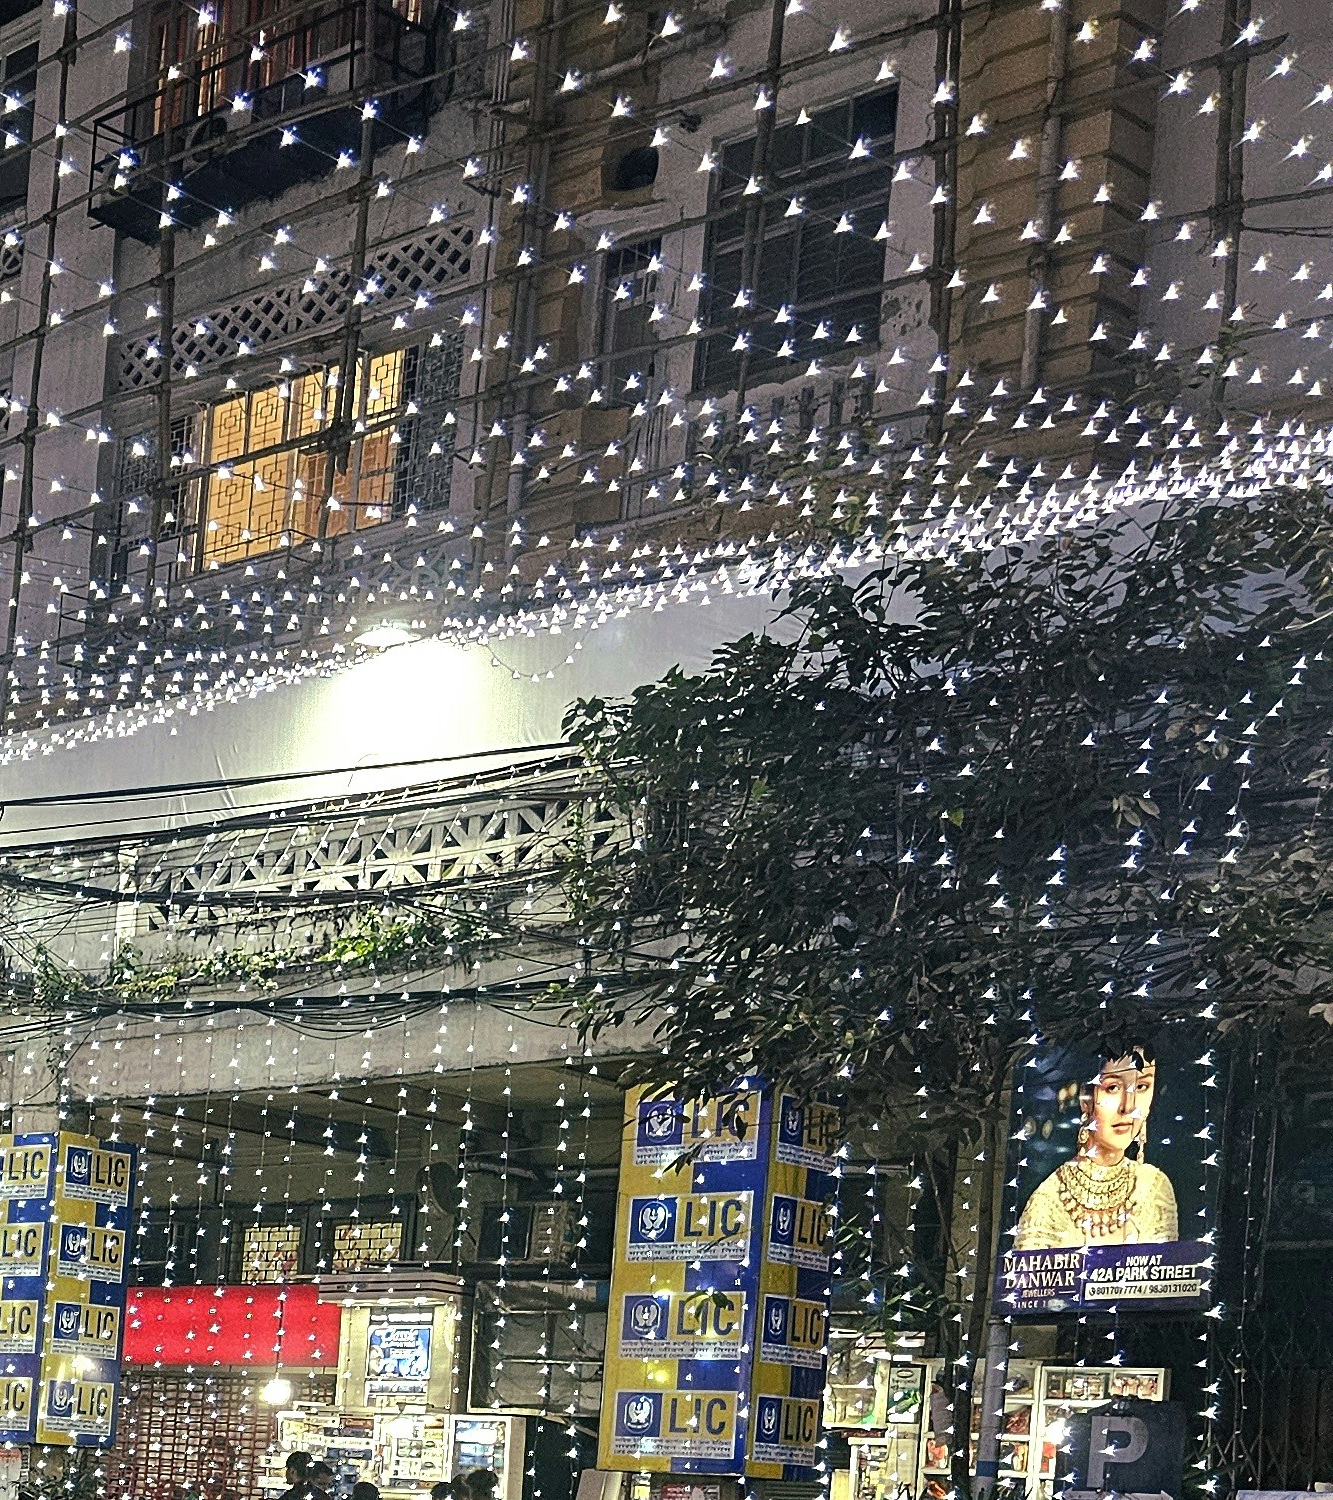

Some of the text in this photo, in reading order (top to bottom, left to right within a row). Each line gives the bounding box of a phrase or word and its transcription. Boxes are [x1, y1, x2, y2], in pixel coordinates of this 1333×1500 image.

[9, 1151, 44, 1180] LIC
[95, 1155, 126, 1187] LIC
[684, 1200, 743, 1237] LIC
[2, 1229, 37, 1257] LIC
[90, 1233, 120, 1263] LIC
[1003, 1254, 1080, 1272] MAHABIR
[1090, 1264, 1197, 1282] 42A PARK STREET
[1125, 1255, 1162, 1267] NOW AT
[1005, 1270, 1076, 1289] DANWAR
[1021, 1288, 1056, 1298] JEWELLERS
[84, 1310, 115, 1340] LIC
[677, 1300, 735, 1336] LIC
[791, 1305, 821, 1344] LIC
[77, 1387, 108, 1416] LIC
[669, 1398, 727, 1435] LIC
[784, 1404, 815, 1442] LIC
[1086, 1415, 1150, 1488] P
